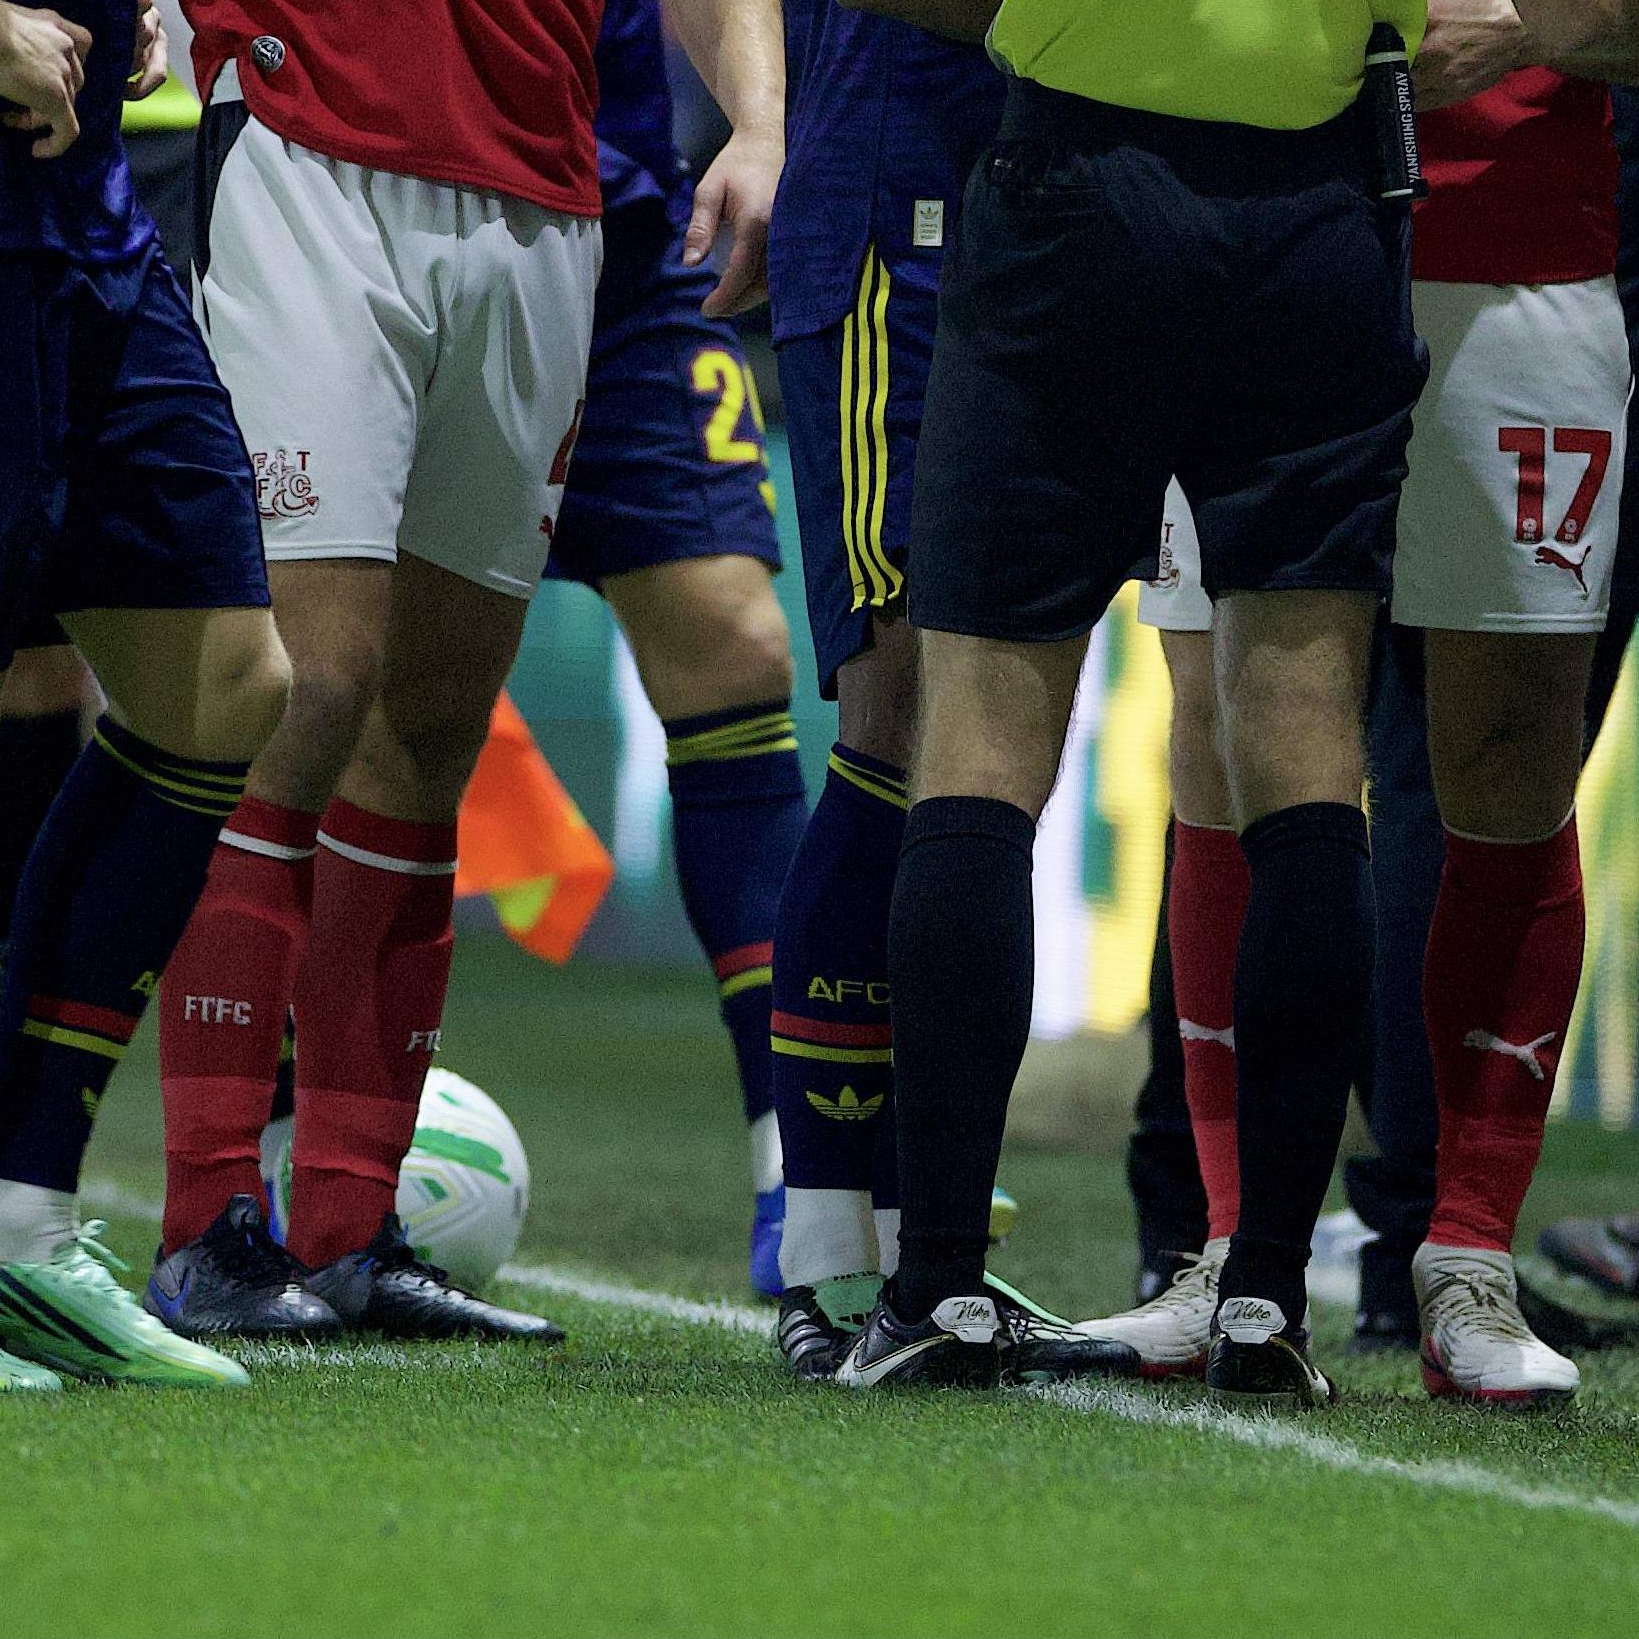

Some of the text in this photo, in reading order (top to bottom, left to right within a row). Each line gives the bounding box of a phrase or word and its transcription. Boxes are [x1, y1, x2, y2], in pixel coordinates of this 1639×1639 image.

[1394, 71, 1421, 184] VANISHING SPRAY
[691, 349, 767, 469] 2
[1498, 427, 1612, 543] 17
[807, 976, 890, 1004] AFC
[184, 994, 252, 1026] FTFC
[953, 1301, 991, 1320] Nike
[1231, 1300, 1271, 1321] Nike
